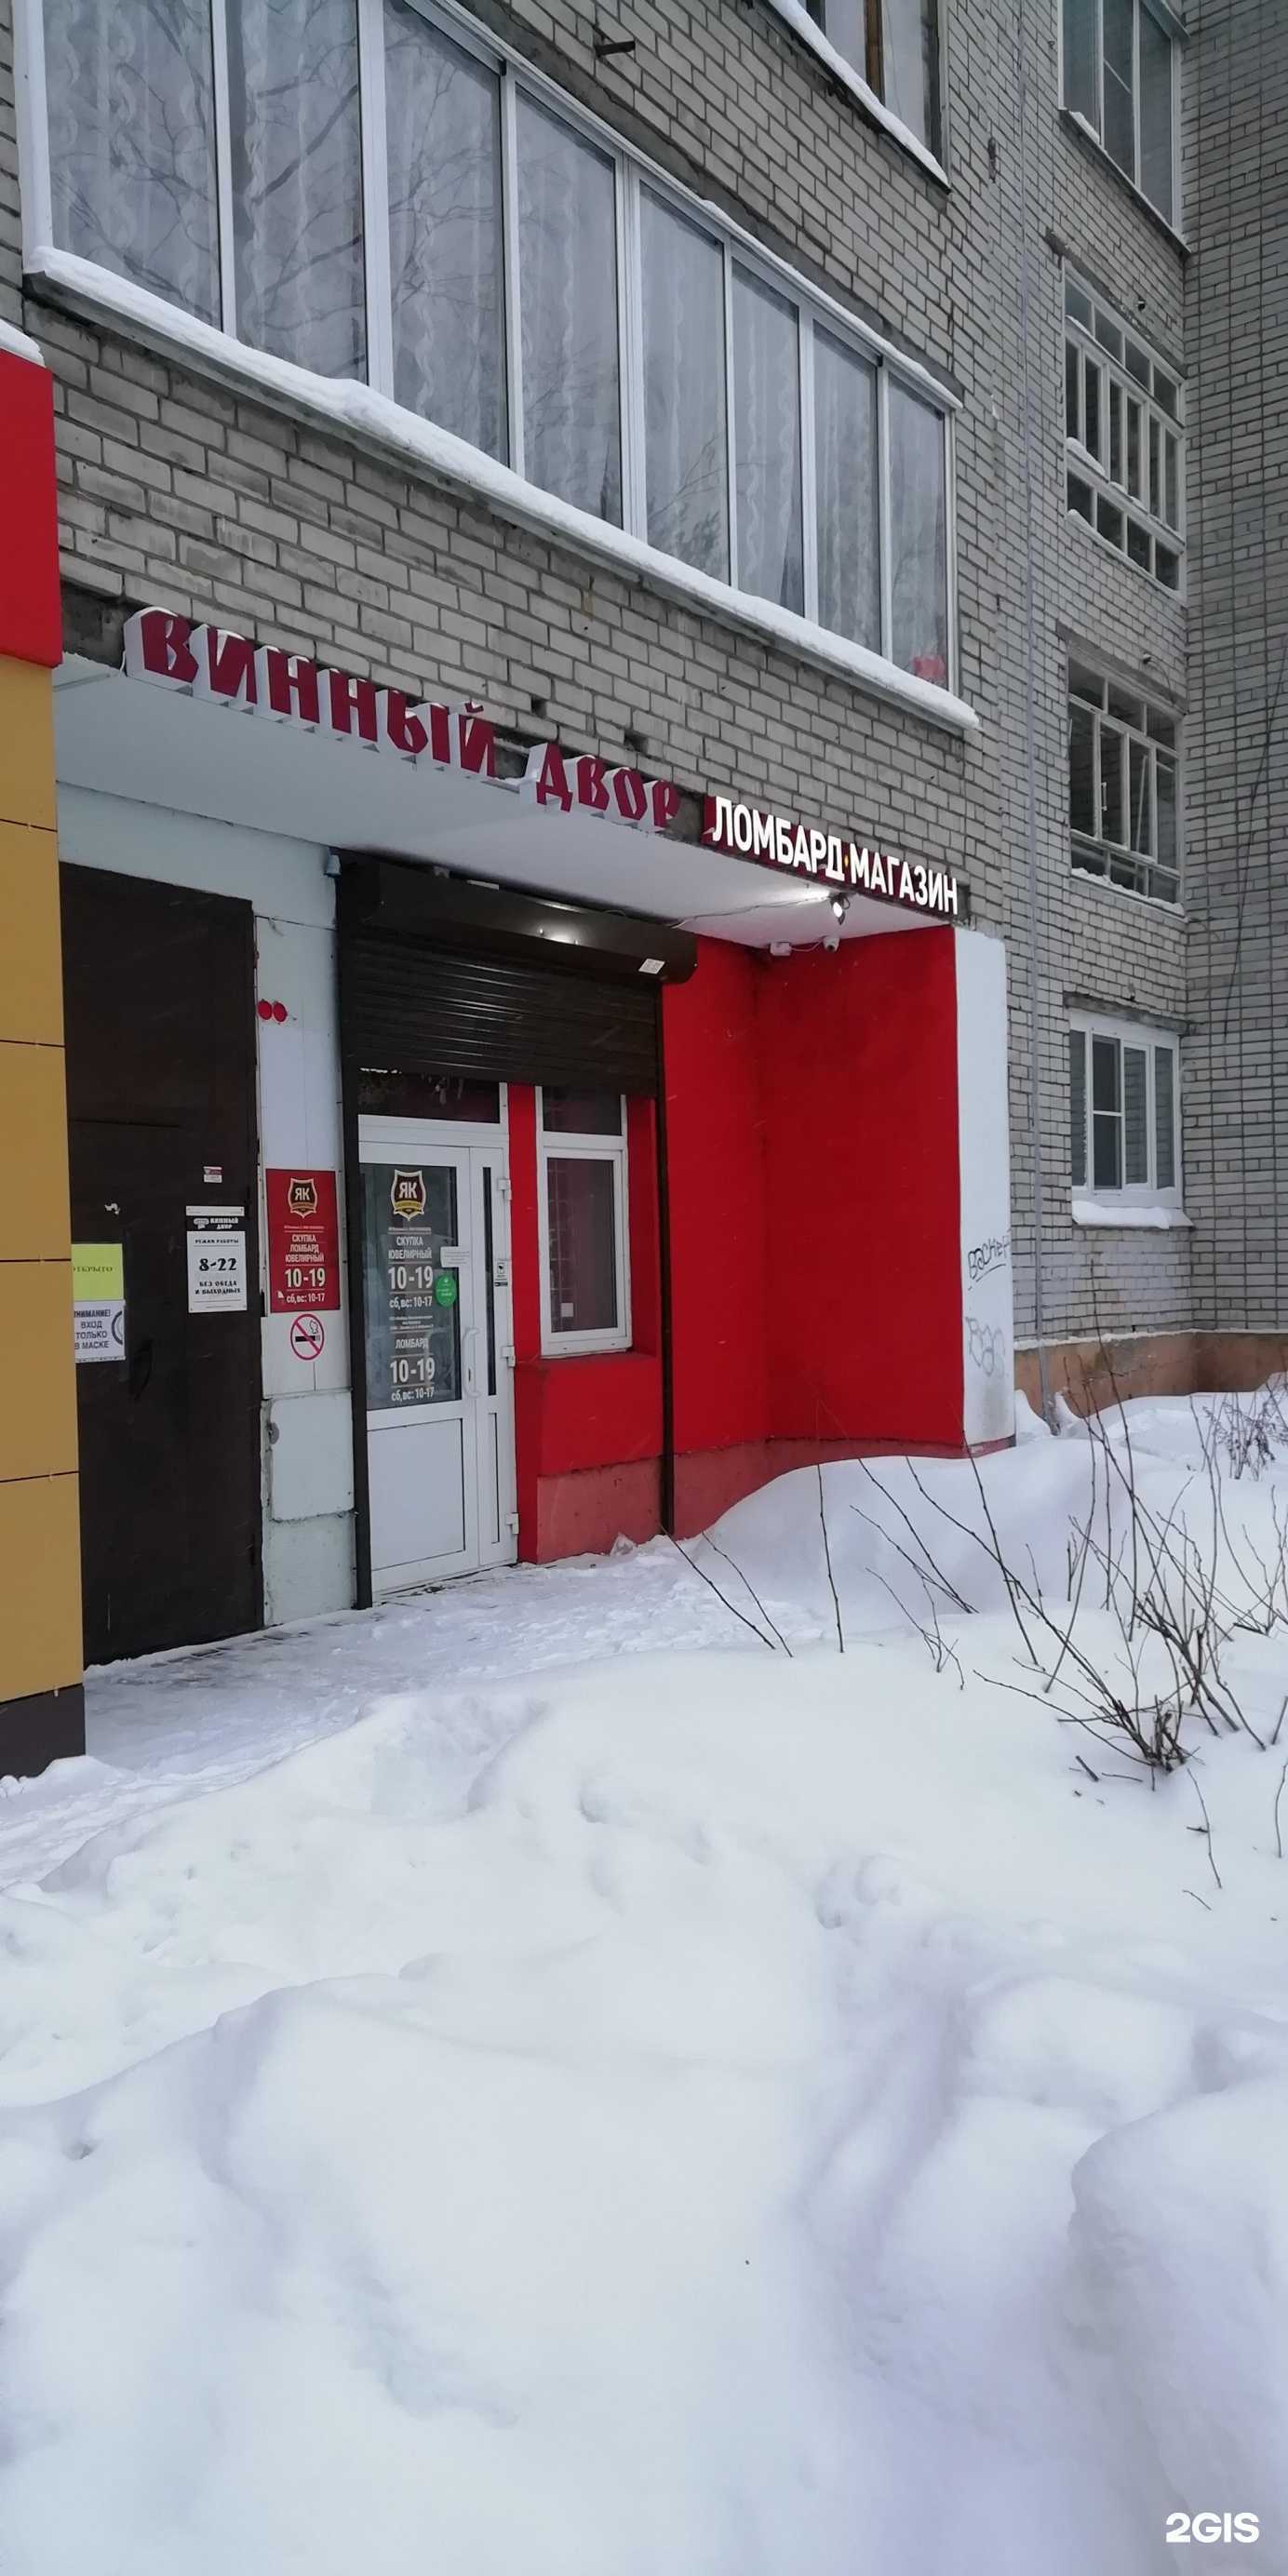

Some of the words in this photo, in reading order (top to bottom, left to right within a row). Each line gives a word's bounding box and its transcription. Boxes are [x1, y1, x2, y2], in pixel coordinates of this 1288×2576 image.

[138, 608, 496, 778] ВИННЫЙ
[535, 742, 681, 828] ДВОР
[712, 796, 845, 882] ЛОМБАРД
[848, 842, 959, 915] МАГАЗИН
[295, 1187, 311, 1201] ЯК
[399, 1182, 418, 1199] ЯК
[292, 1233, 316, 1242] СКУПКА
[396, 1236, 423, 1246] СКУПКА
[289, 1243, 320, 1254] ЛОМБАРД
[388, 1247, 433, 1259] ЮВЕЛИРНЫЙ
[285, 1252, 325, 1263] ЮВЕЛИРНЫЙ
[198, 1257, 237, 1272] 8-22
[308, 1292, 325, 1303] 10-17
[413, 1295, 433, 1308] 10-17
[81, 1322, 102, 1330] ВХОД
[75, 1331, 108, 1340] ТОЛЬКО
[82, 1341, 110, 1349] МАСКЕ
[395, 1338, 429, 1349] ЛОМБАРД
[415, 1387, 435, 1399] 10-17
